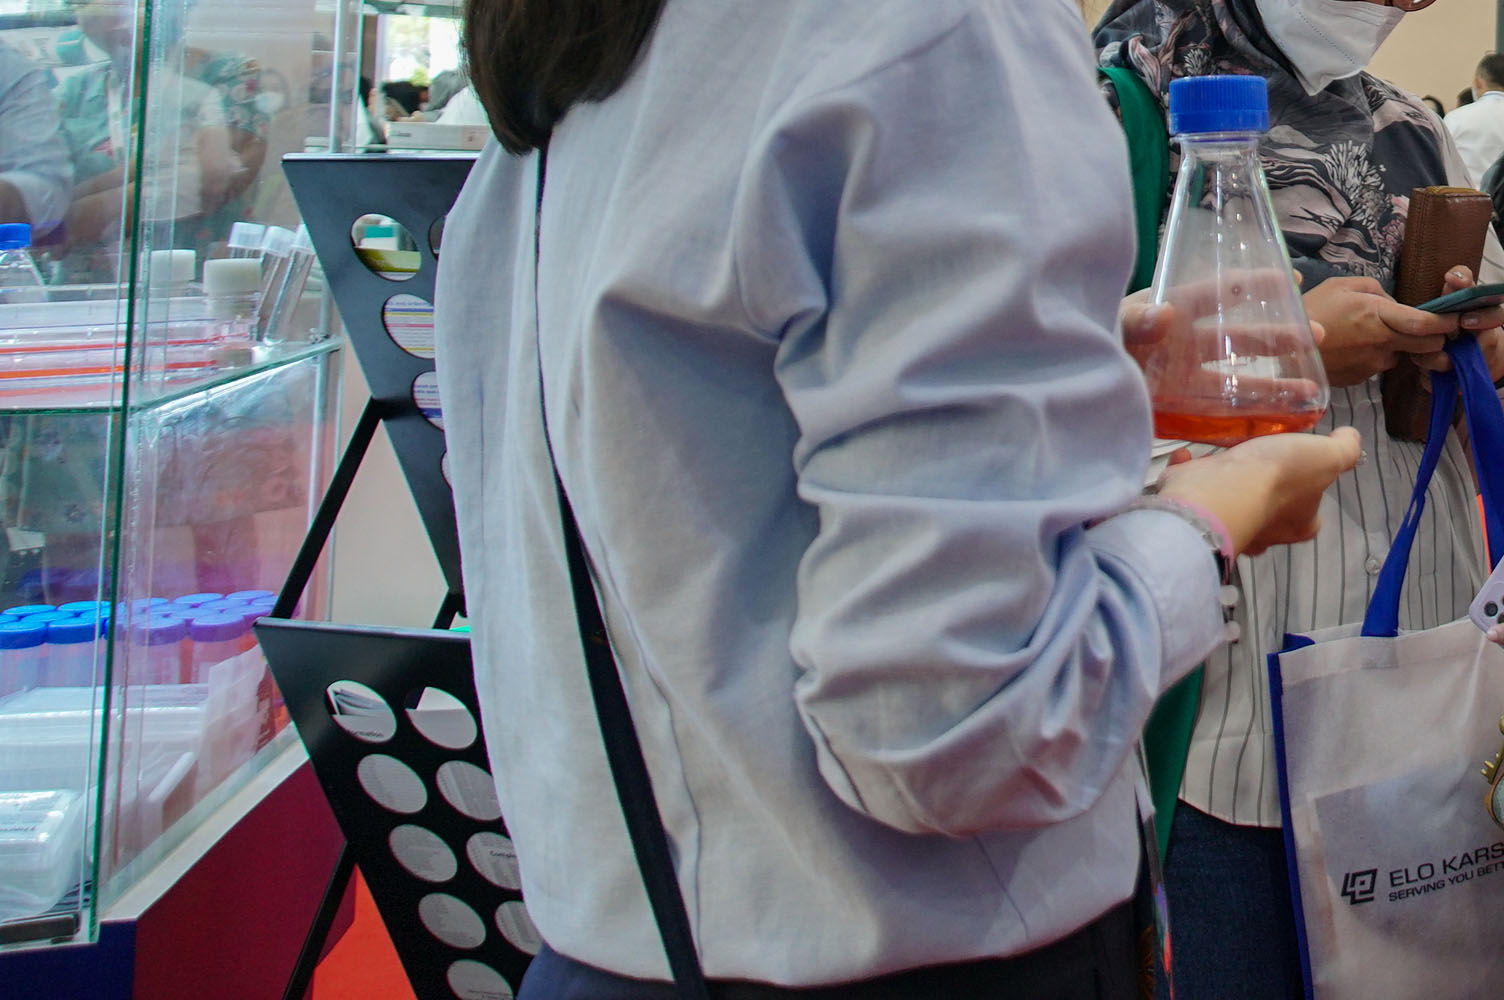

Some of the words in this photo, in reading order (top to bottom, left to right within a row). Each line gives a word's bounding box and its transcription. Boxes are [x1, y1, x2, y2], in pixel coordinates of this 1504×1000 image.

[1389, 862, 1435, 887] ELO
[1389, 879, 1445, 902] SERVING
[1448, 872, 1475, 886] YOU
